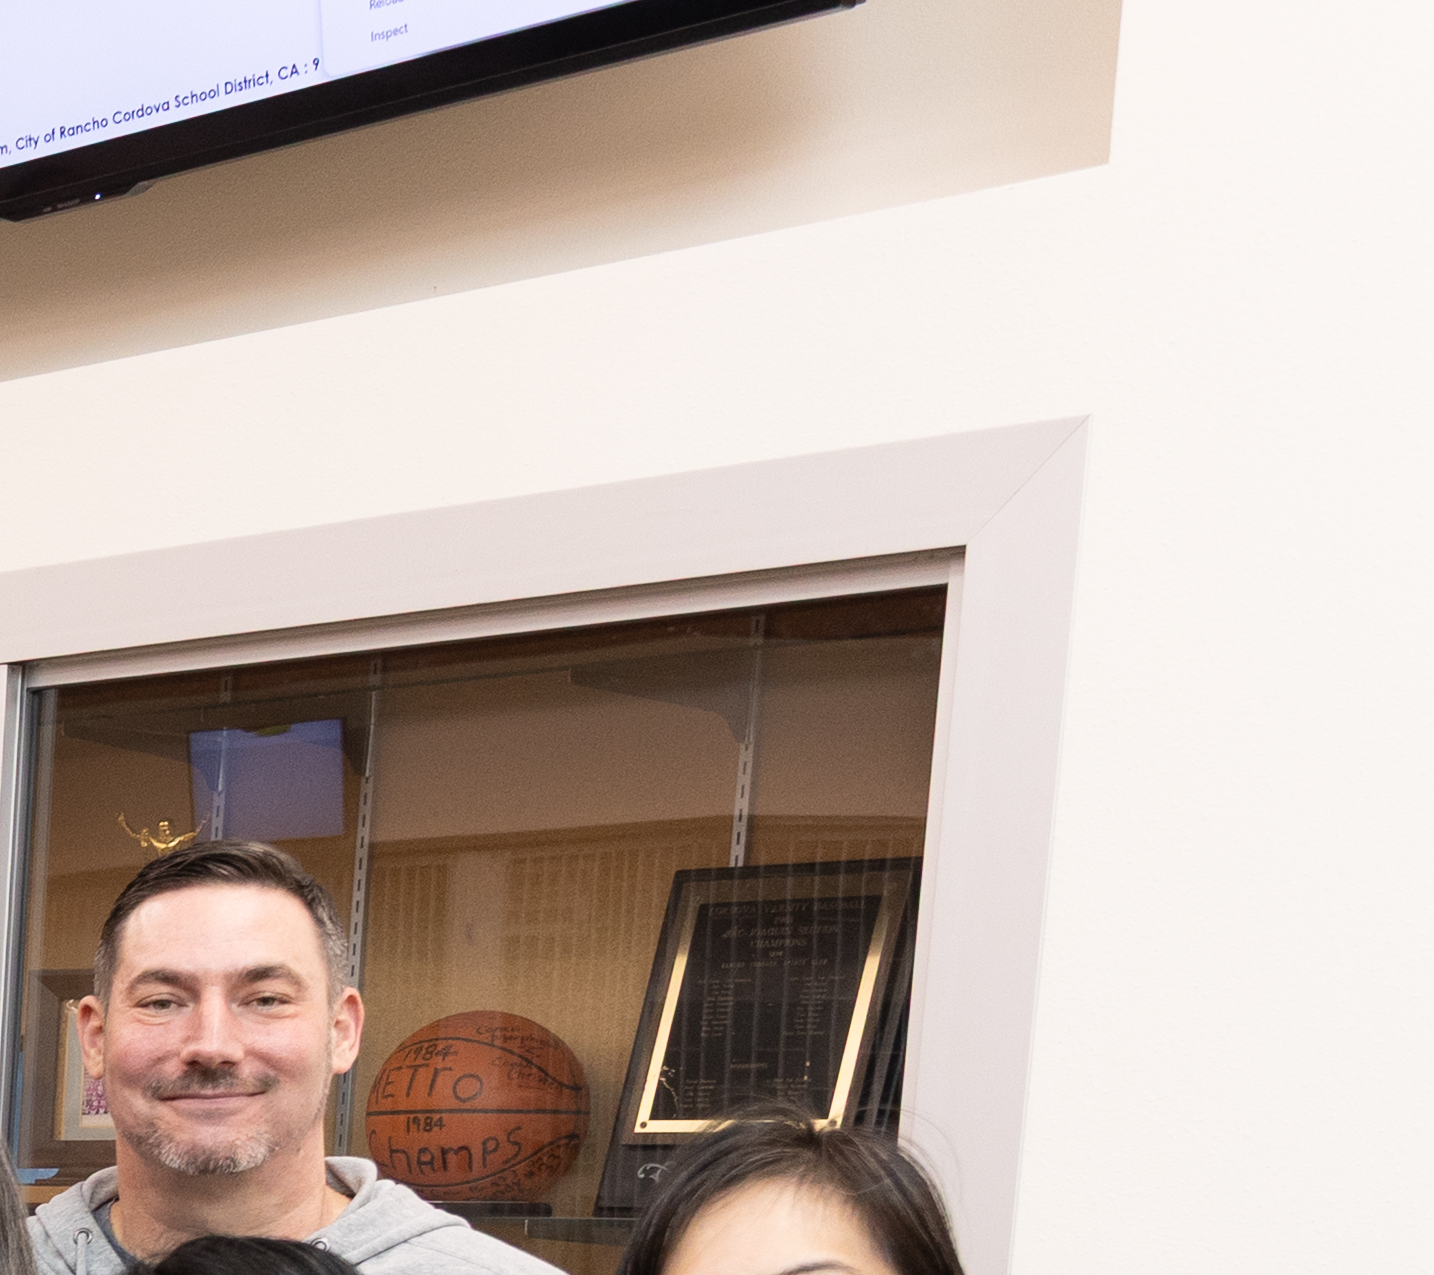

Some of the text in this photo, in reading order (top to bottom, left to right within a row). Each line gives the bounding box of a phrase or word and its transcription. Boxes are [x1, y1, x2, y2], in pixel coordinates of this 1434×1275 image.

[370, 23, 408, 42] Inspect
[15, 134, 40, 152] City
[43, 127, 56, 143] of
[59, 117, 109, 139] Rancho
[112, 99, 170, 125] Cordova
[174, 83, 220, 109] School
[224, 70, 274, 95] District,
[277, 63, 300, 81] CA
[405, 1116, 446, 1134] 1984
